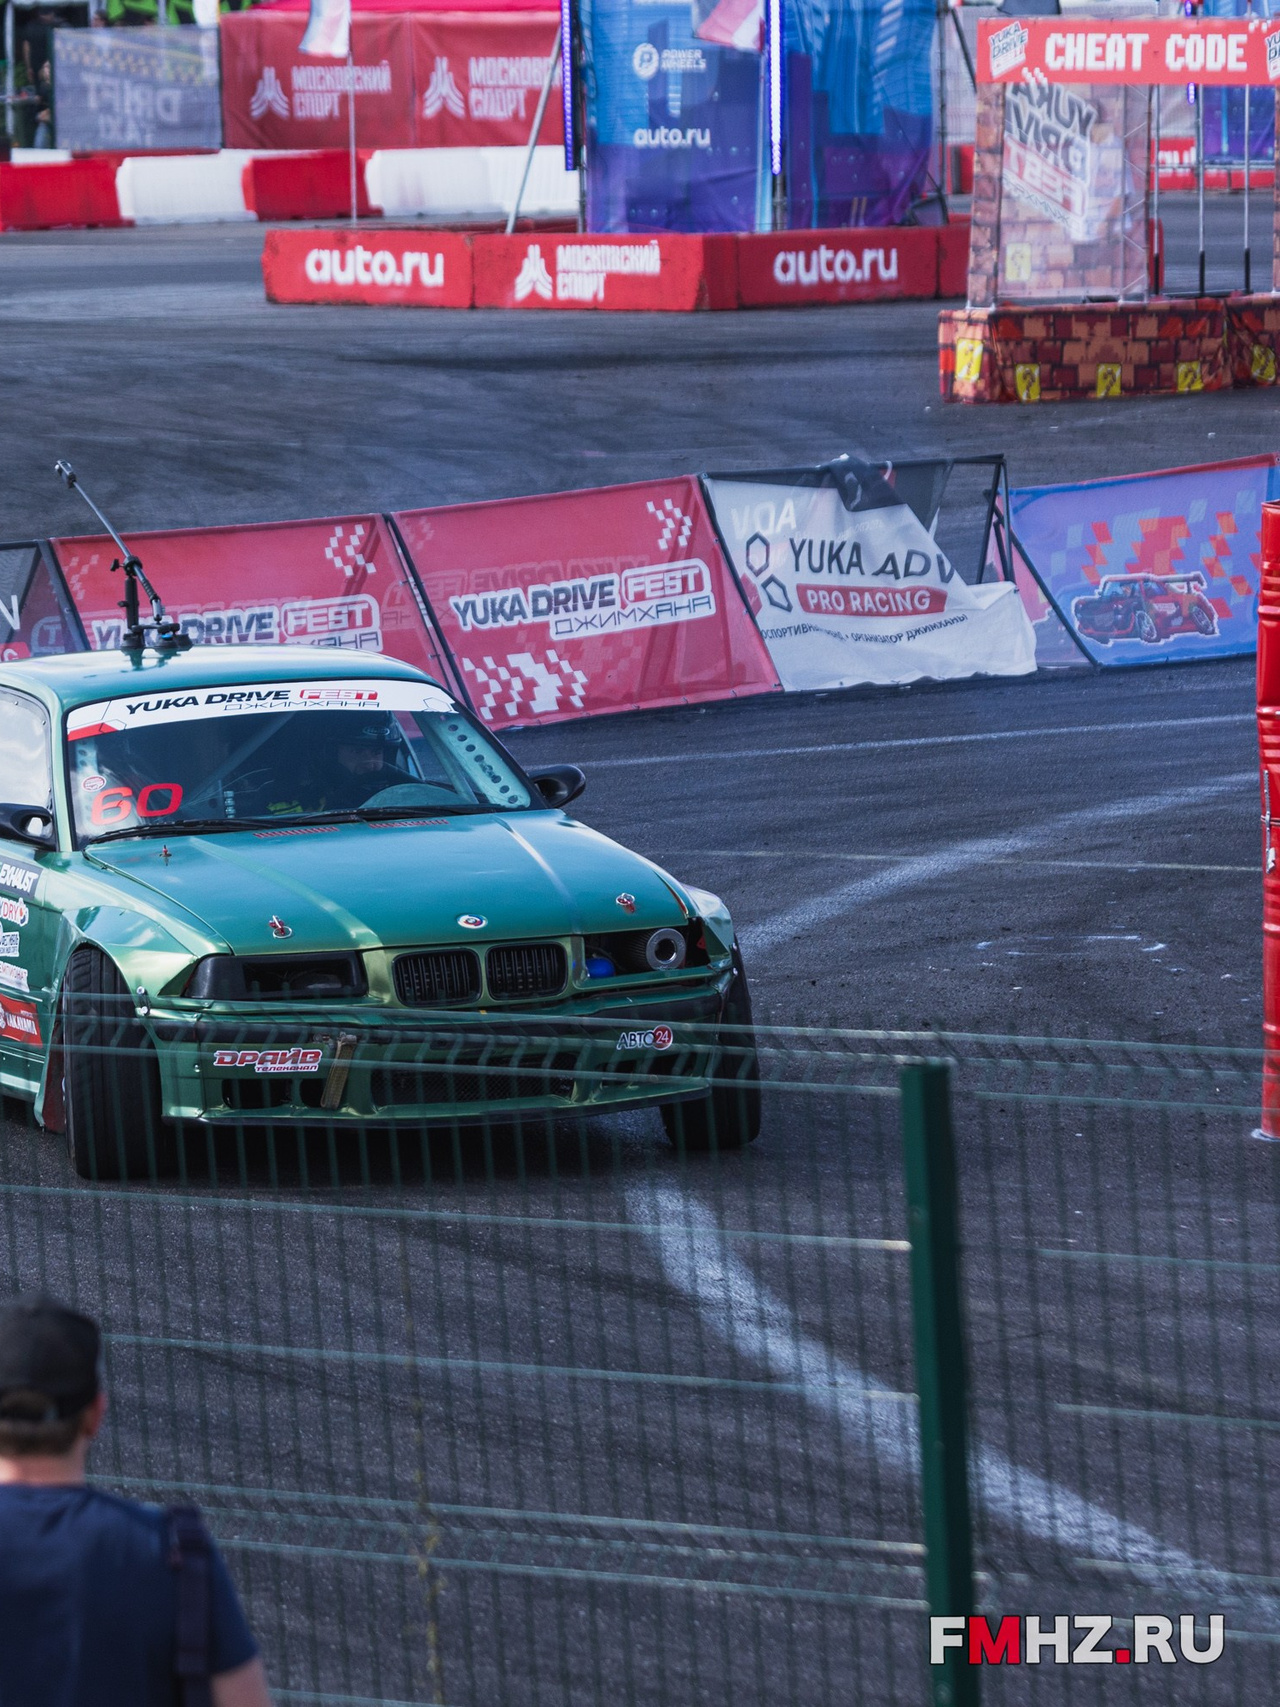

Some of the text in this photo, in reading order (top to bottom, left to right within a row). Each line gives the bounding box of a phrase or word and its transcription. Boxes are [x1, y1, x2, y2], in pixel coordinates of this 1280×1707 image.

[1045, 33, 1149, 72] CHEAT
[1166, 33, 1247, 72] CODE
[633, 126, 711, 148] auto.ru
[305, 245, 445, 286] auto.ru
[773, 244, 898, 285] auto.ru
[789, 538, 955, 584] YUKA ADV
[453, 568, 700, 627] YUKA DRIVE FEST
[555, 594, 711, 635] ДЖИМХАНА
[807, 589, 931, 614] PRO RACING
[181, 609, 275, 643] DRIVE
[288, 602, 369, 634] FEST
[126, 695, 199, 715] YUKA
[205, 689, 291, 705] DRIVE
[224, 700, 380, 711] ДЖИМХАНА
[91, 783, 183, 826] 60
